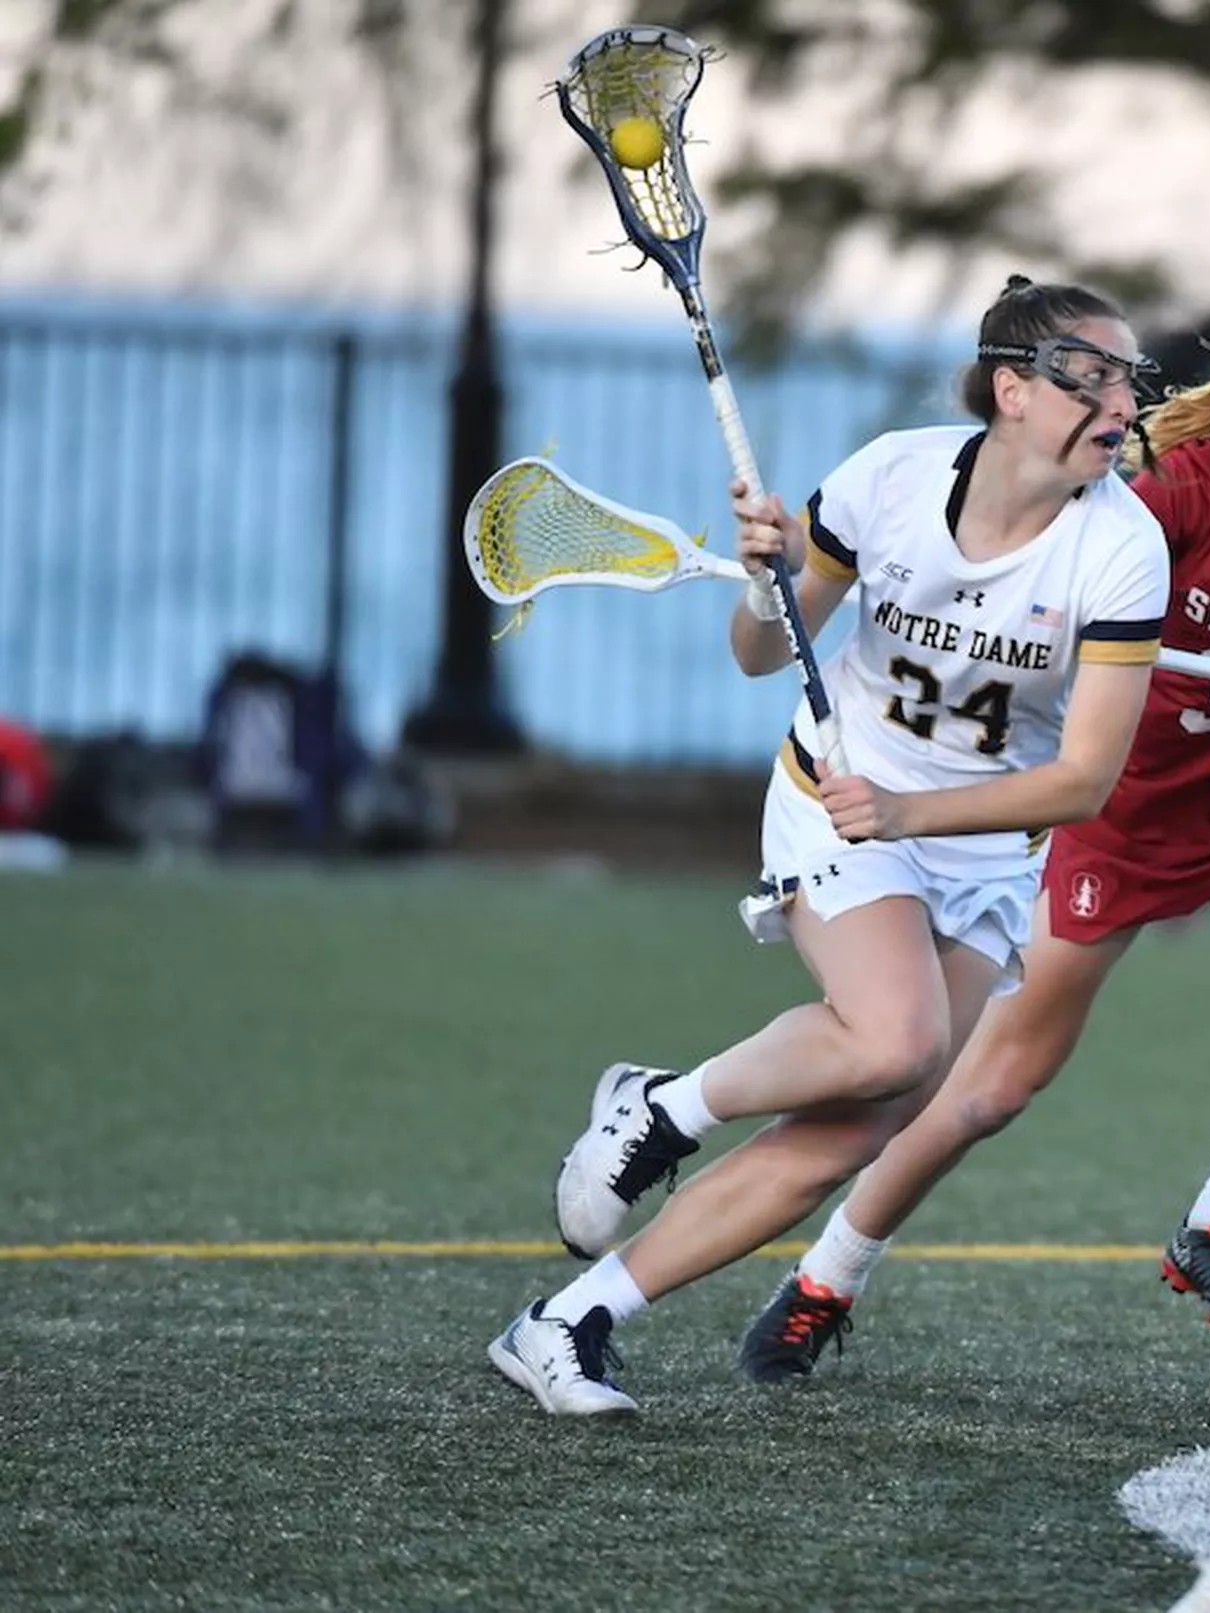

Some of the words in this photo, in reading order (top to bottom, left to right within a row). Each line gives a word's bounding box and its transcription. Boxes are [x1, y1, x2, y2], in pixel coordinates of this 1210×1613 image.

[875, 600, 961, 653] NOTRE
[969, 630, 1053, 670] DAME
[884, 655, 1015, 756] 24
